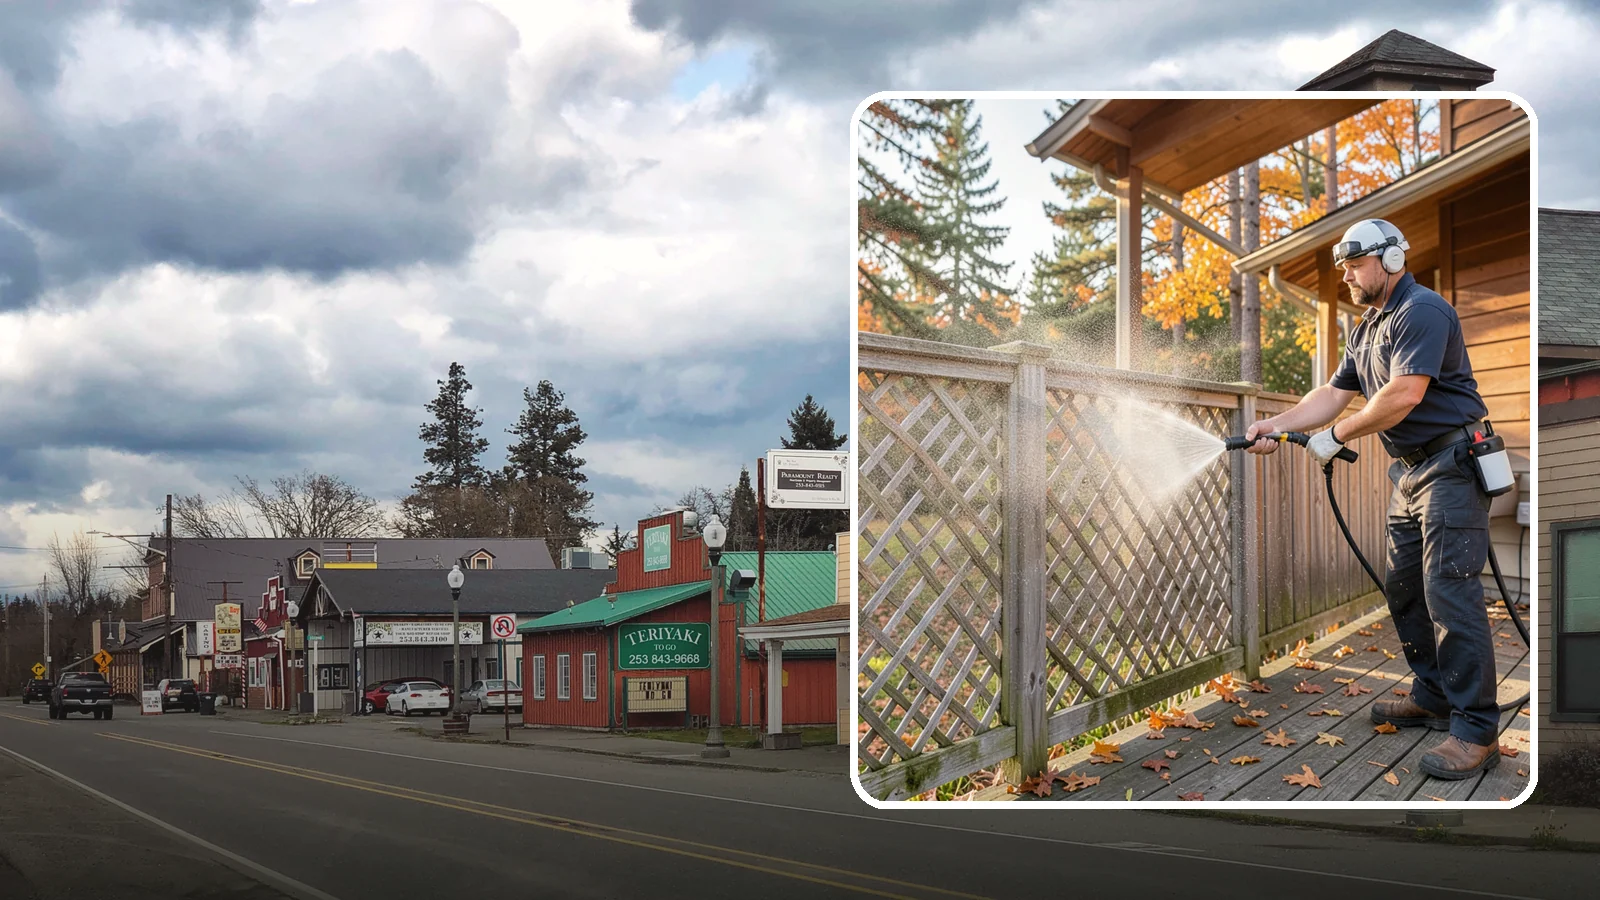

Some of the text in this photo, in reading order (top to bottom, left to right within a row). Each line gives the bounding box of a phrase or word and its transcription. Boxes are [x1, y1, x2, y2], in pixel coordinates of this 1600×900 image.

[625, 628, 702, 646] TERIYAKI
[629, 654, 700, 664] 253 843-9668
